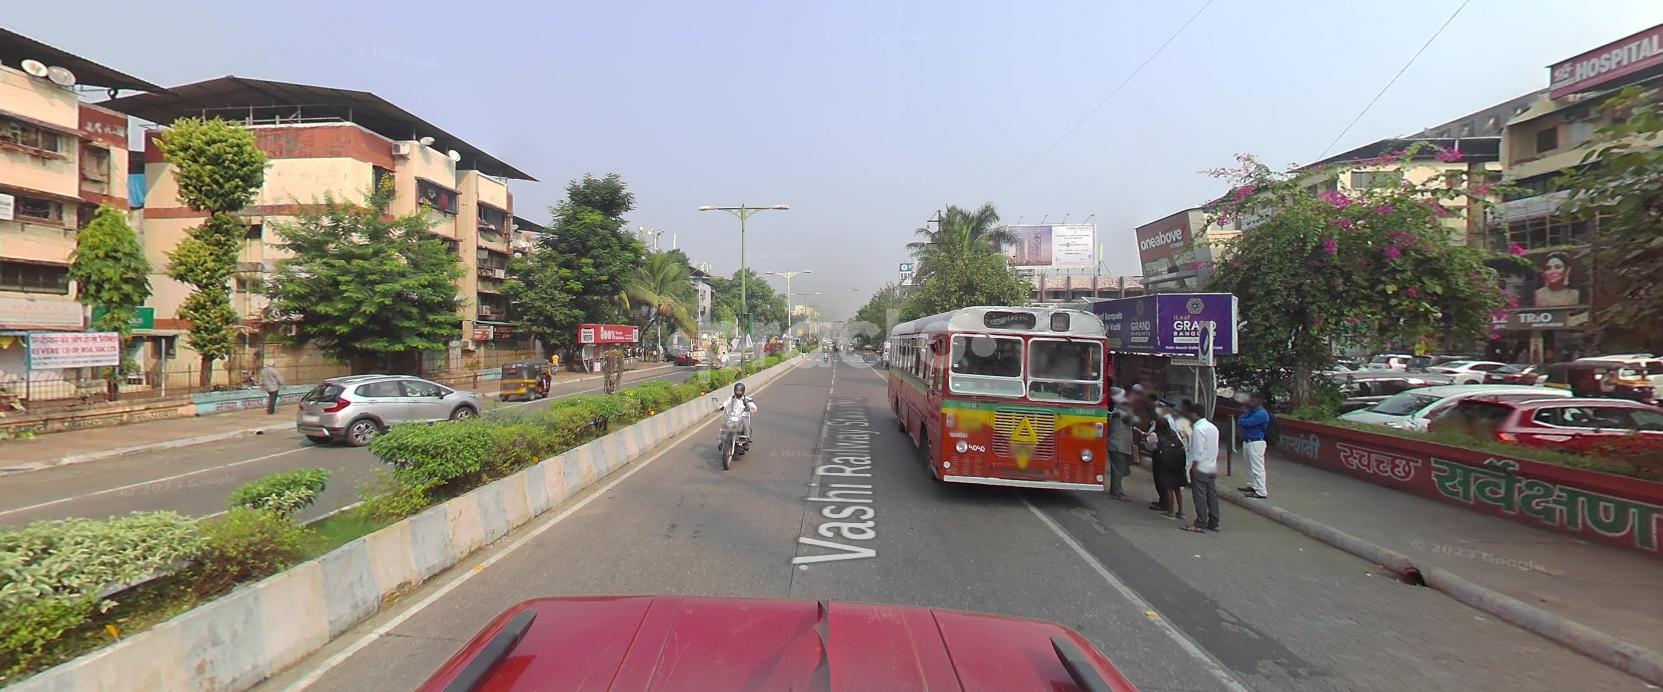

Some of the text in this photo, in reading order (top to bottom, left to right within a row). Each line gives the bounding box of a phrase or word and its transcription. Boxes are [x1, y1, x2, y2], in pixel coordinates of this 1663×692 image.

[1575, 34, 1663, 81] HOSPITAL
[1140, 229, 1182, 250] oneabove
[1131, 321, 1150, 331] GRAND
[1173, 320, 1217, 331] GRAD
[1430, 456, 1663, 551] सर्वेक्षण
